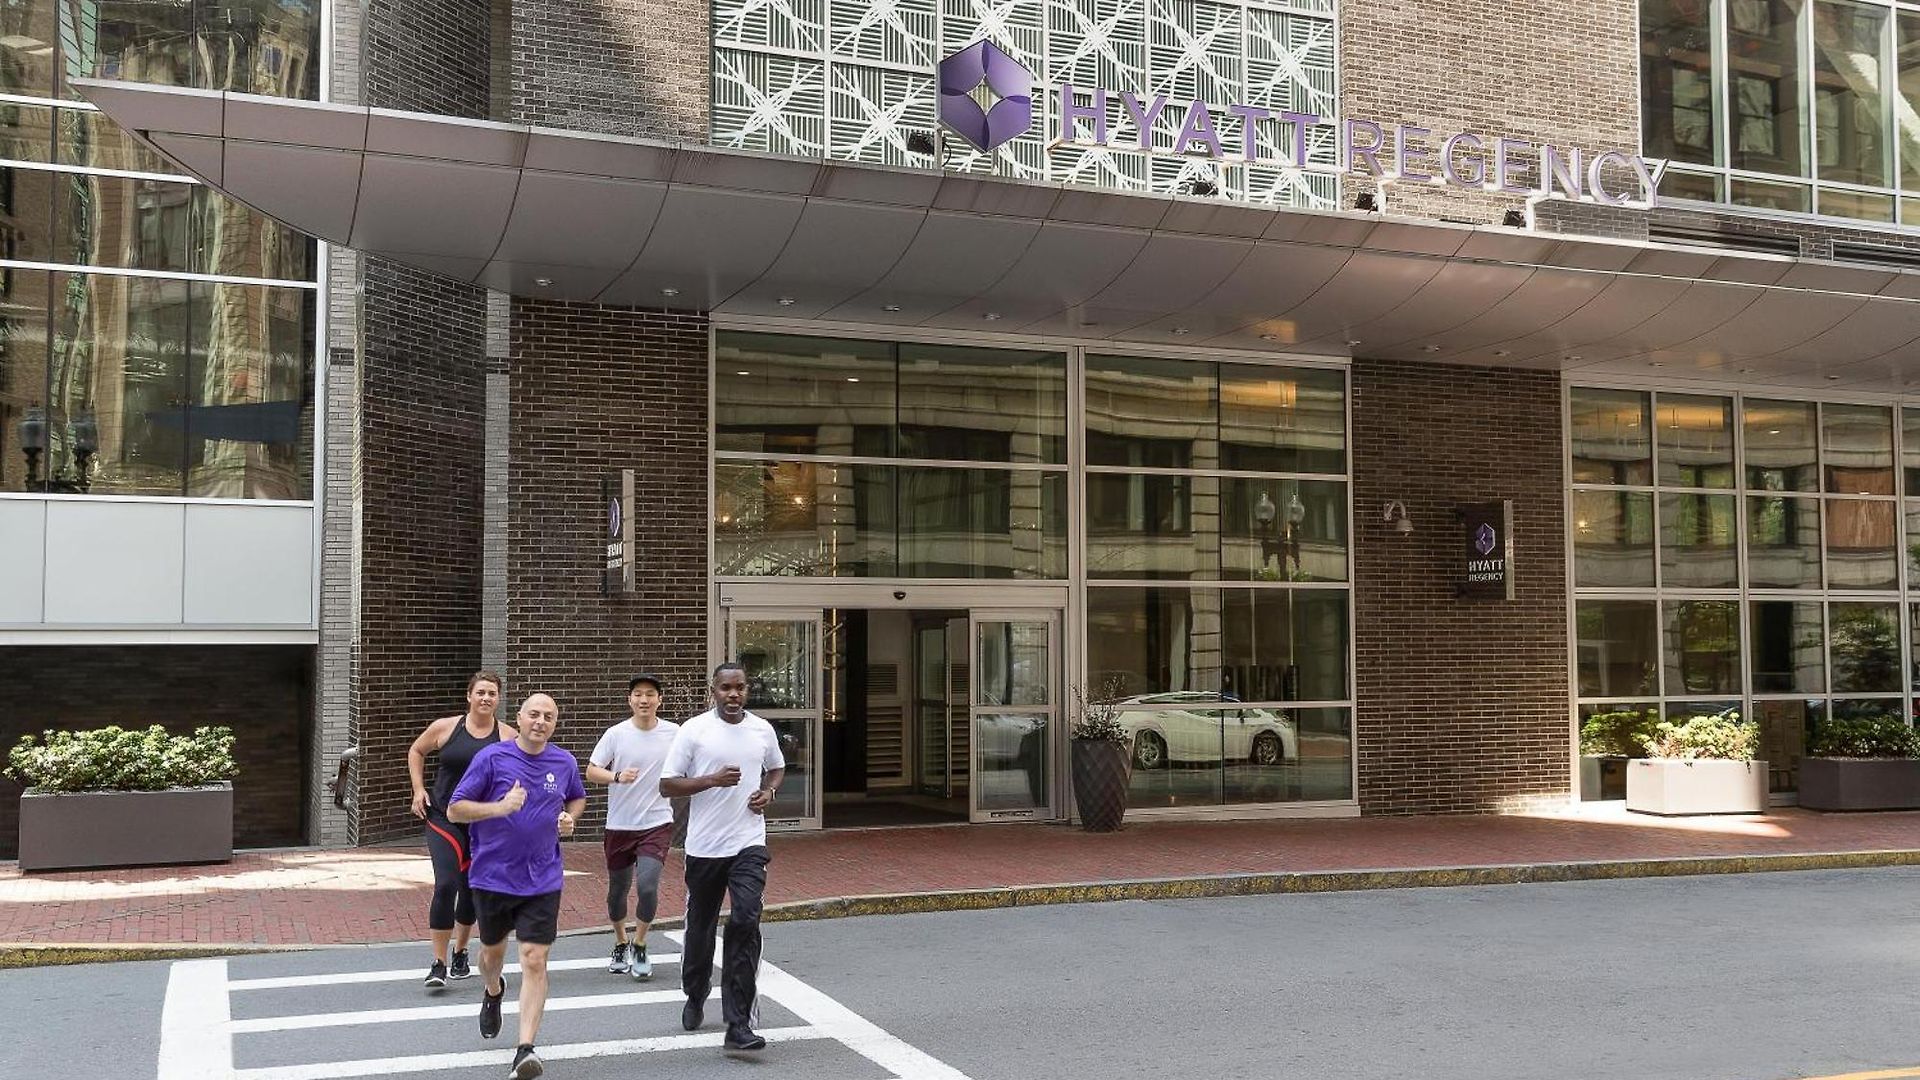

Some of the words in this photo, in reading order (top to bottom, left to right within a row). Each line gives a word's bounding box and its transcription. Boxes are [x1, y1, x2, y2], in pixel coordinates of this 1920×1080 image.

[1060, 84, 1320, 169] HYATT
[1344, 118, 1669, 208] REGENCY
[1468, 559, 1504, 572] HYATT
